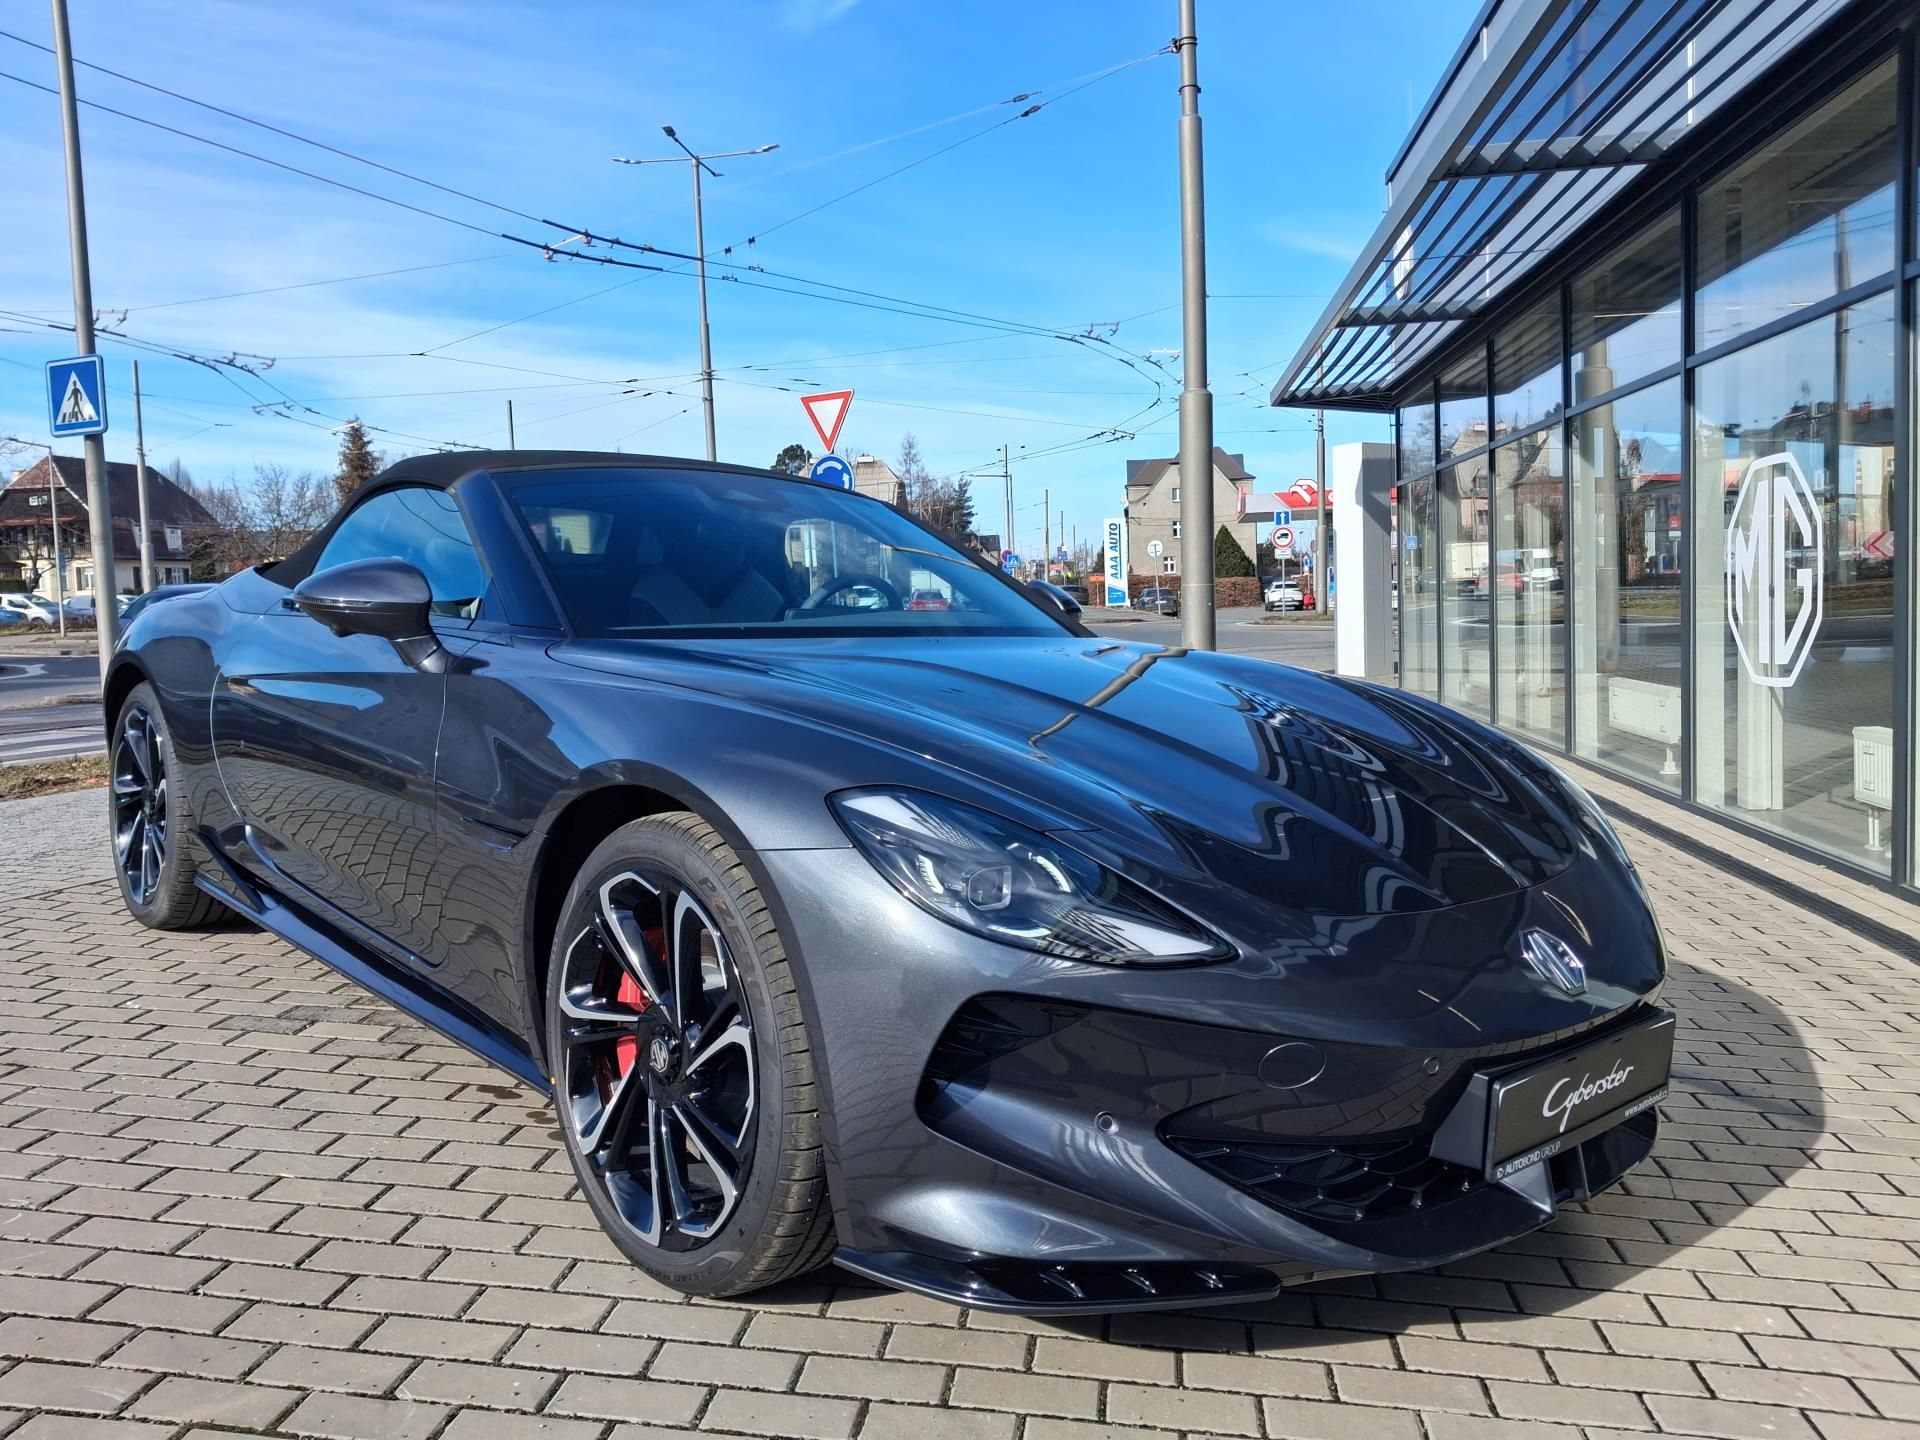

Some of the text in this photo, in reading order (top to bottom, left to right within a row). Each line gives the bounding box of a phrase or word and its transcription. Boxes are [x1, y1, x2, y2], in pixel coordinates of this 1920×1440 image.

[1108, 522, 1119, 553] AUTO
[1110, 556, 1120, 580] AAA
[1735, 475, 1813, 665] MG
[1542, 1058, 1634, 1133] Cyberster
[1504, 1141, 1561, 1176] AUTOBOND GROUP
